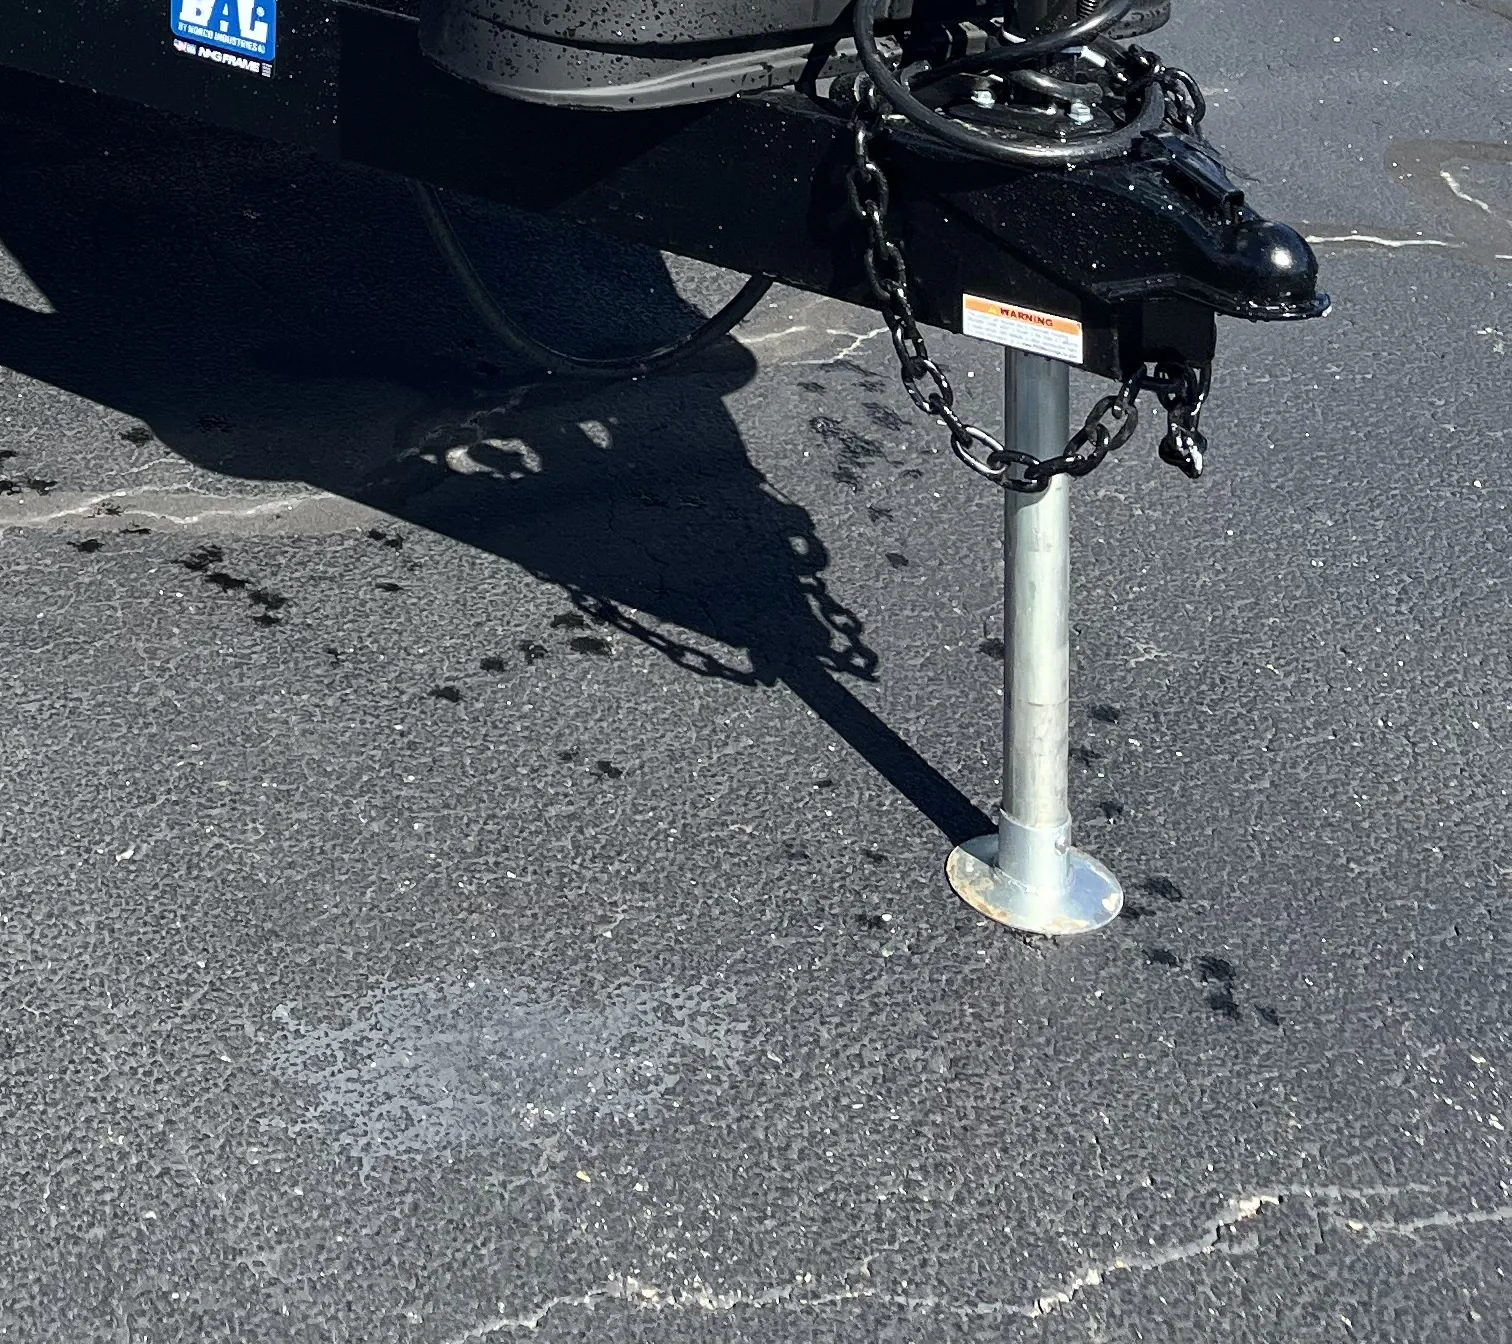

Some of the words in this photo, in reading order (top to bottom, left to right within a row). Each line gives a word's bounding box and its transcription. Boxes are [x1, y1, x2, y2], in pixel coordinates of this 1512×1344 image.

[214, 32, 258, 52] INDUSTRIES
[222, 53, 260, 73] FRAME
[1000, 307, 1053, 327] WARNING
